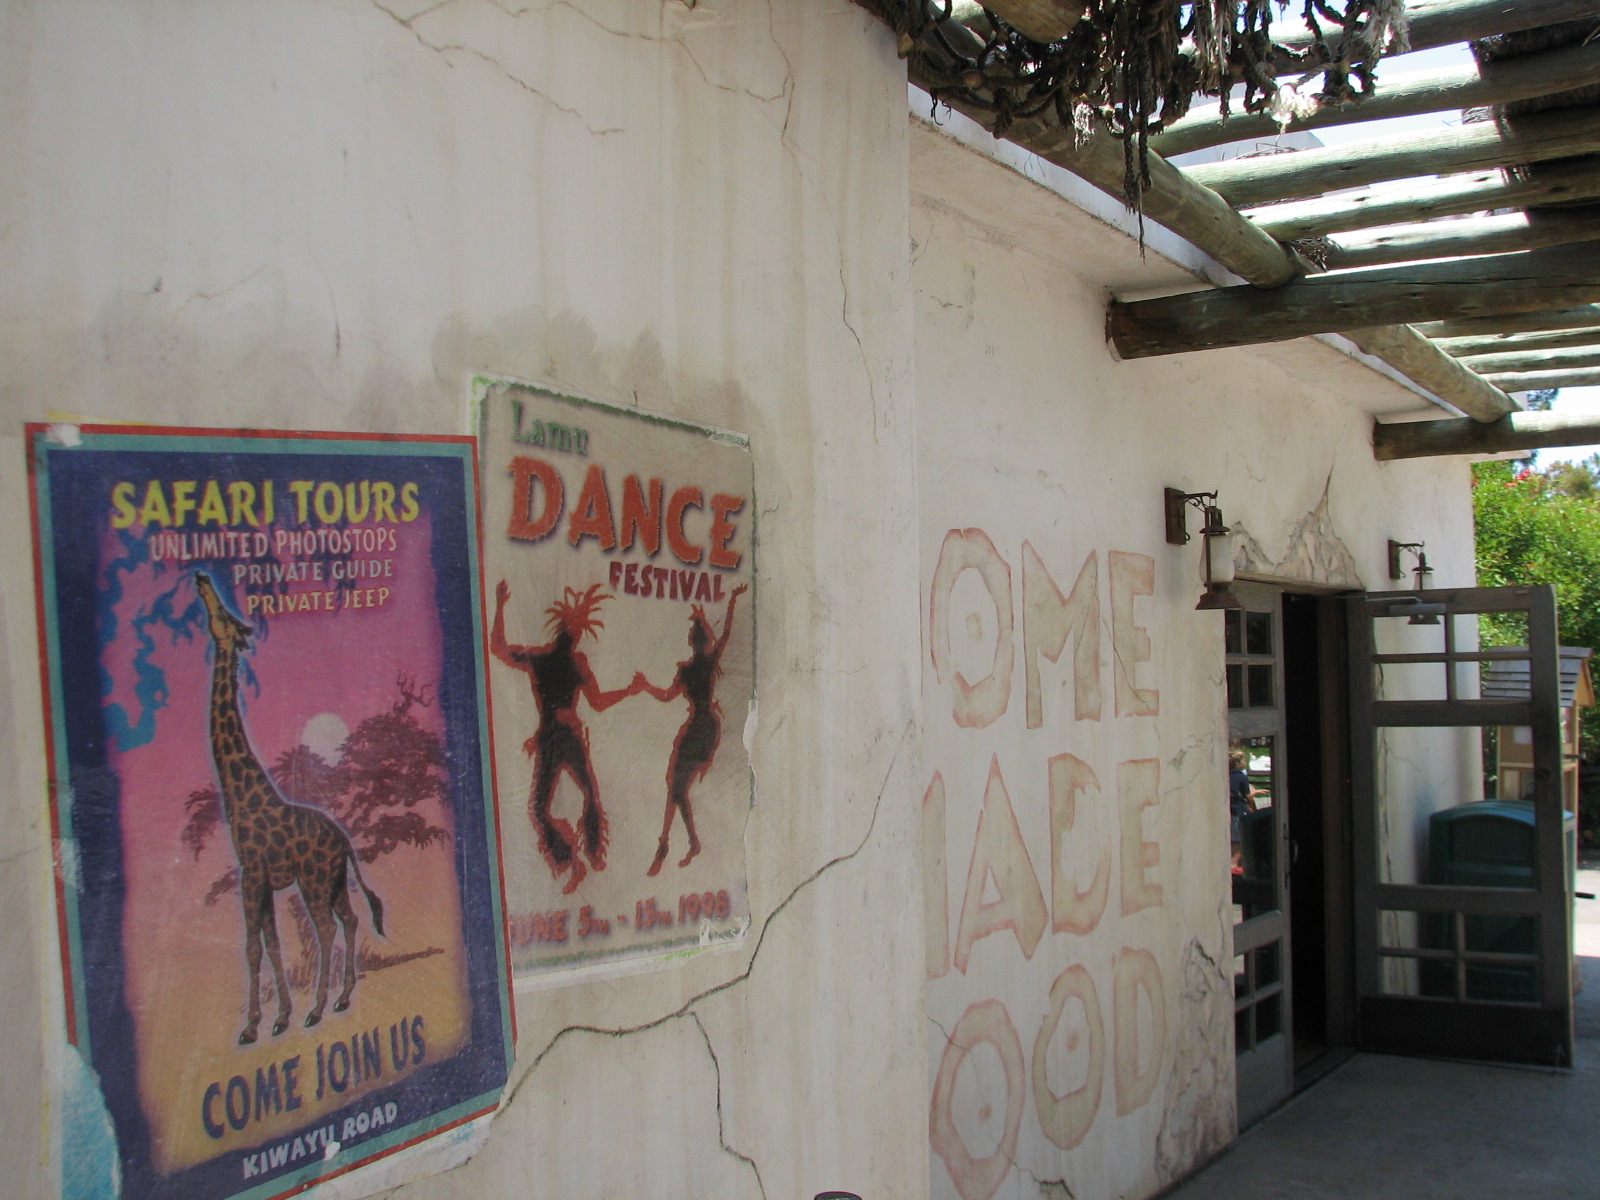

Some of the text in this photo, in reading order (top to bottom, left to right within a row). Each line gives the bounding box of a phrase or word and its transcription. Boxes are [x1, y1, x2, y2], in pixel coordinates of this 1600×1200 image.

[111, 480, 421, 529] SAFARI TOURS
[507, 455, 745, 569] DANCE
[148, 526, 398, 563] UNLIMITED PHOTOSTOPS
[232, 558, 394, 586] PRIVATE GUIDE
[608, 561, 726, 603] FESTIVAL
[246, 587, 391, 616] PRIVATE JEEP
[677, 888, 732, 923] 1998
[202, 1014, 427, 1140] COME JOIN US
[242, 1101, 399, 1180] KIWAYU ROAD
